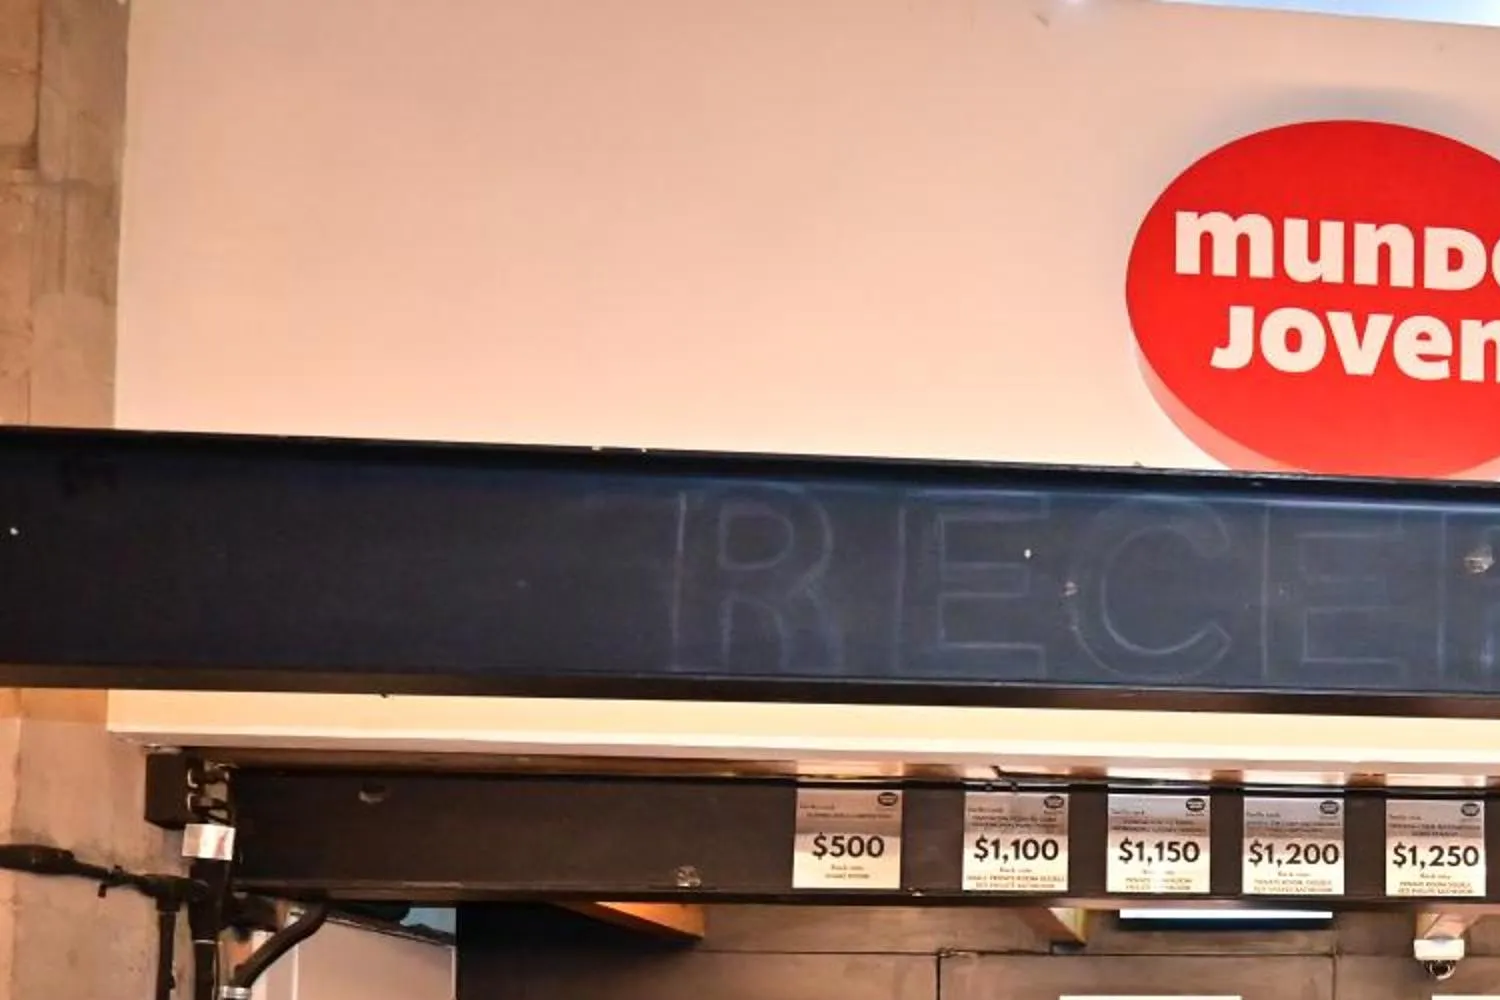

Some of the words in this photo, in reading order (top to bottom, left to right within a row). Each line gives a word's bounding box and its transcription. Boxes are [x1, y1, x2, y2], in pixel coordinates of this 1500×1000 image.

[812, 832, 885, 860] $500
[973, 835, 1059, 864] $1,100
[1119, 837, 1201, 866] $1,150
[1248, 839, 1340, 868] $1,200
[1392, 842, 1480, 870] $1,250
